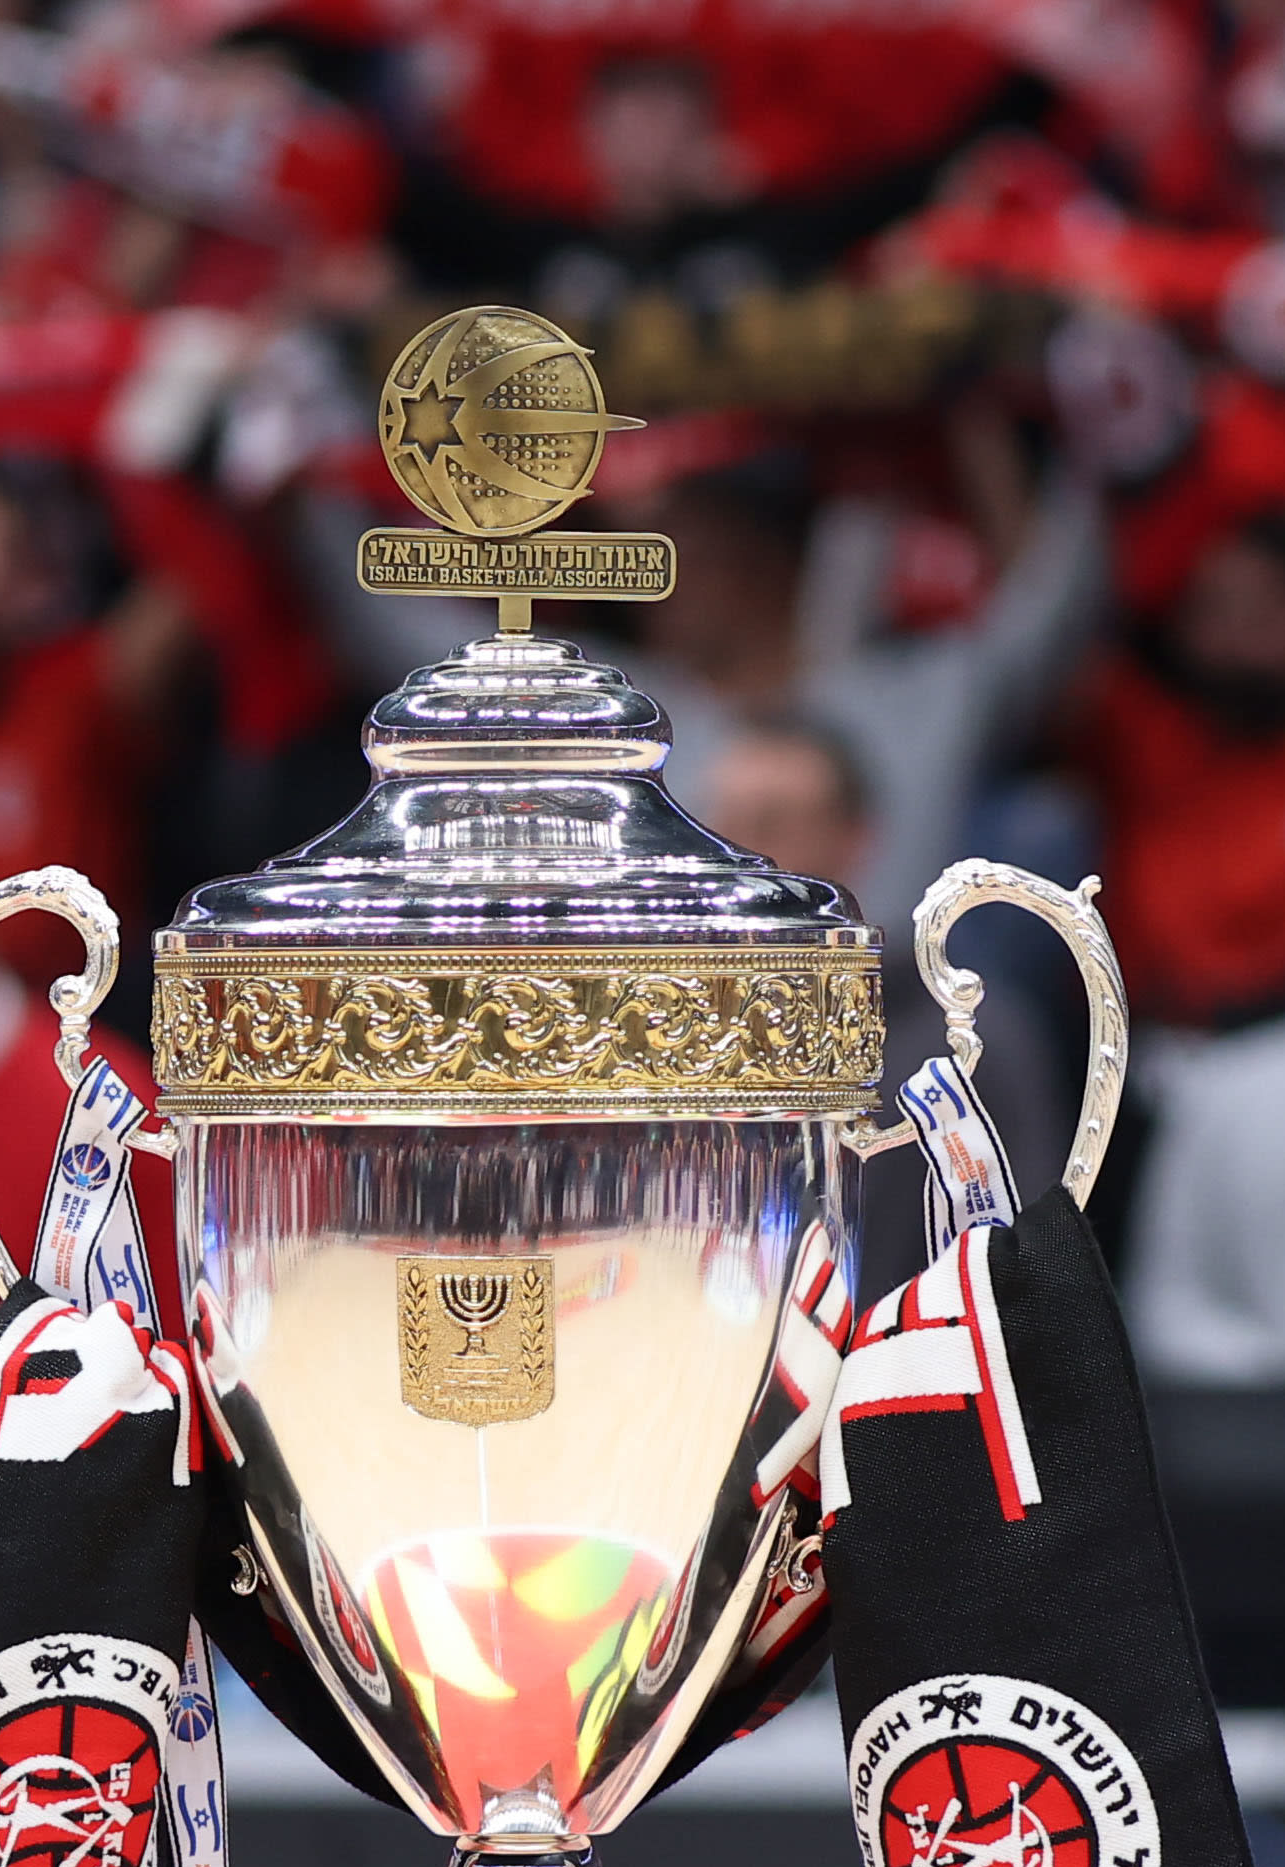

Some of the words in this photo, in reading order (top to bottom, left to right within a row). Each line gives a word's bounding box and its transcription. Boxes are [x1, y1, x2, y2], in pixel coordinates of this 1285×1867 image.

[368, 539, 479, 566] הישראלי
[484, 541, 593, 569] הכדורסל
[599, 546, 664, 570] איגוד
[368, 565, 433, 584] ISRAELI
[439, 566, 548, 587] BASKETBALL
[553, 570, 665, 589] ASSOCIATION
[1009, 1695, 1141, 1827] ירושלים
